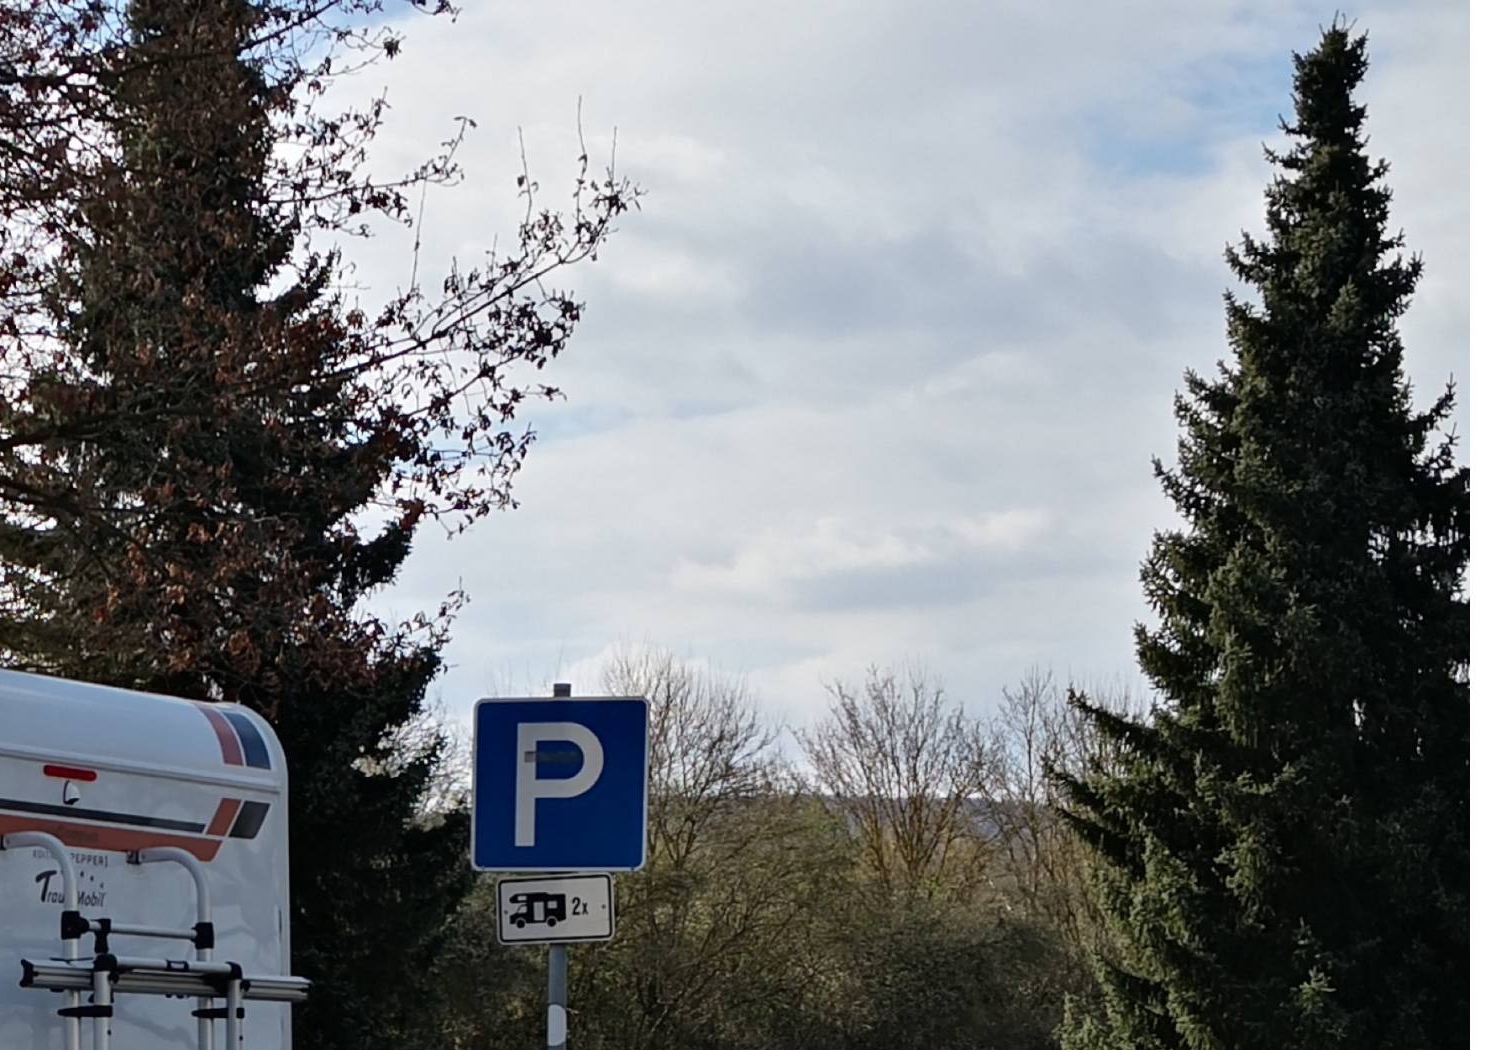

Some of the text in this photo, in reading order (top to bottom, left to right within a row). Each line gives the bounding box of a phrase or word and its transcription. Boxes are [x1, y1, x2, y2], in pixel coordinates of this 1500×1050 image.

[514, 722, 605, 847] P
[35, 870, 107, 908] TrauMobil
[571, 897, 589, 916] 2x
